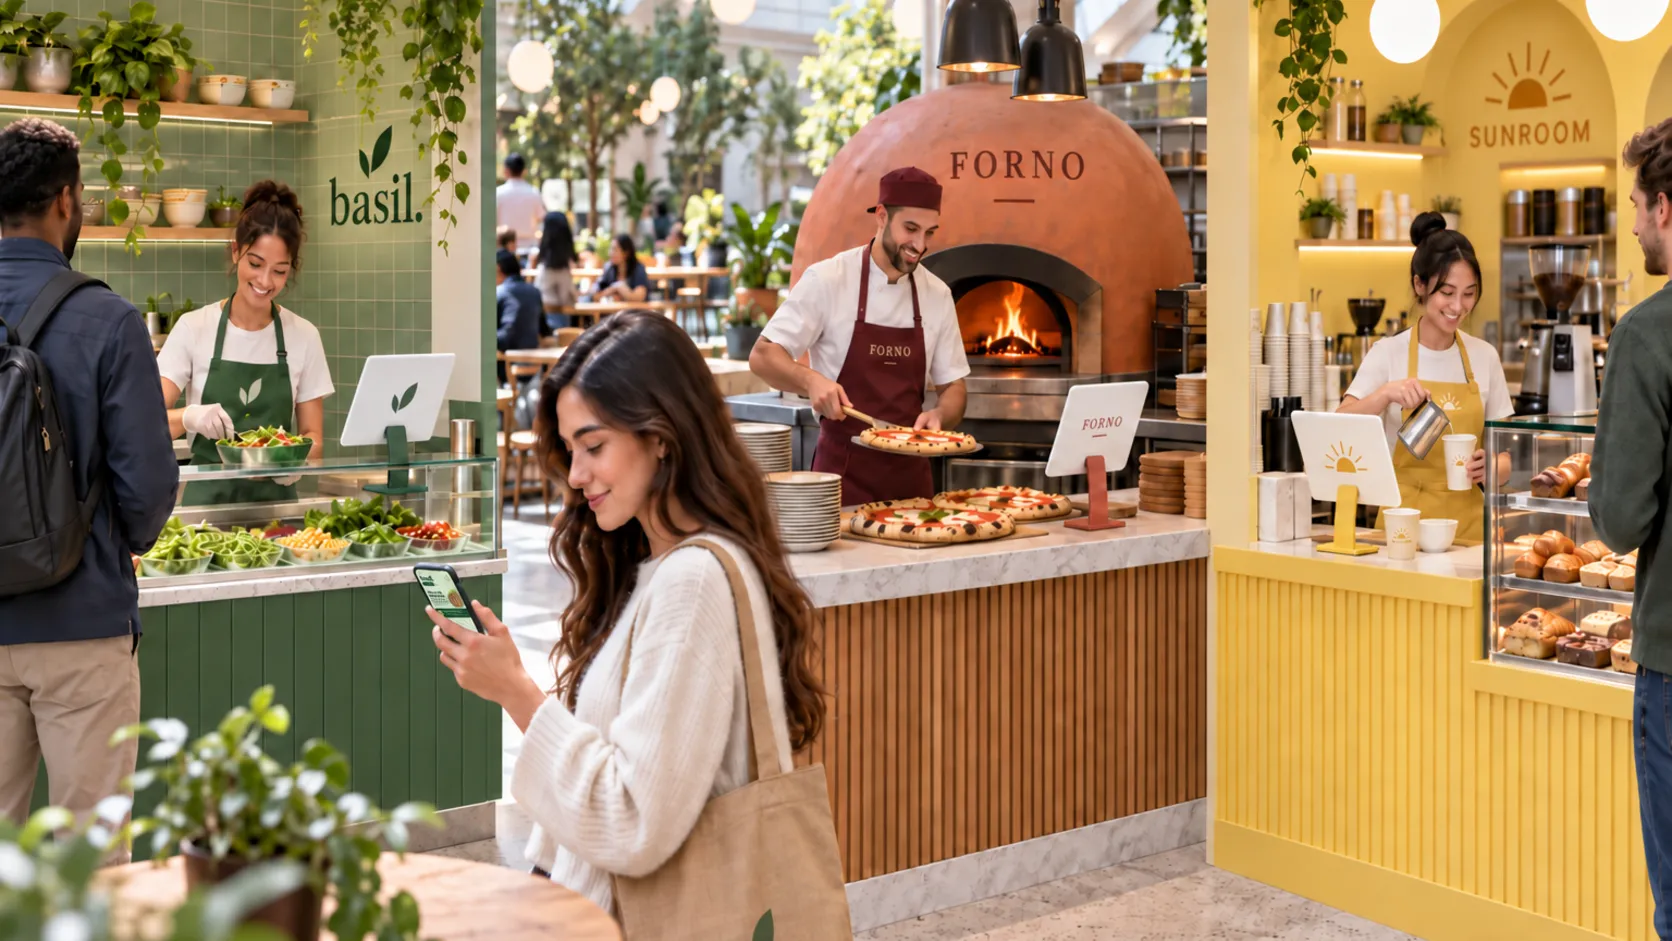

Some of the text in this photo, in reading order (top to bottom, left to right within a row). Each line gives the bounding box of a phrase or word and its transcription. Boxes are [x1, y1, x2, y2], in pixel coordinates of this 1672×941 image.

[1469, 119, 1590, 148] SUNROOM
[950, 150, 1085, 180] FORNO
[329, 171, 423, 226] basil.
[869, 344, 911, 357] FORNO
[1082, 415, 1123, 431] FORNO
